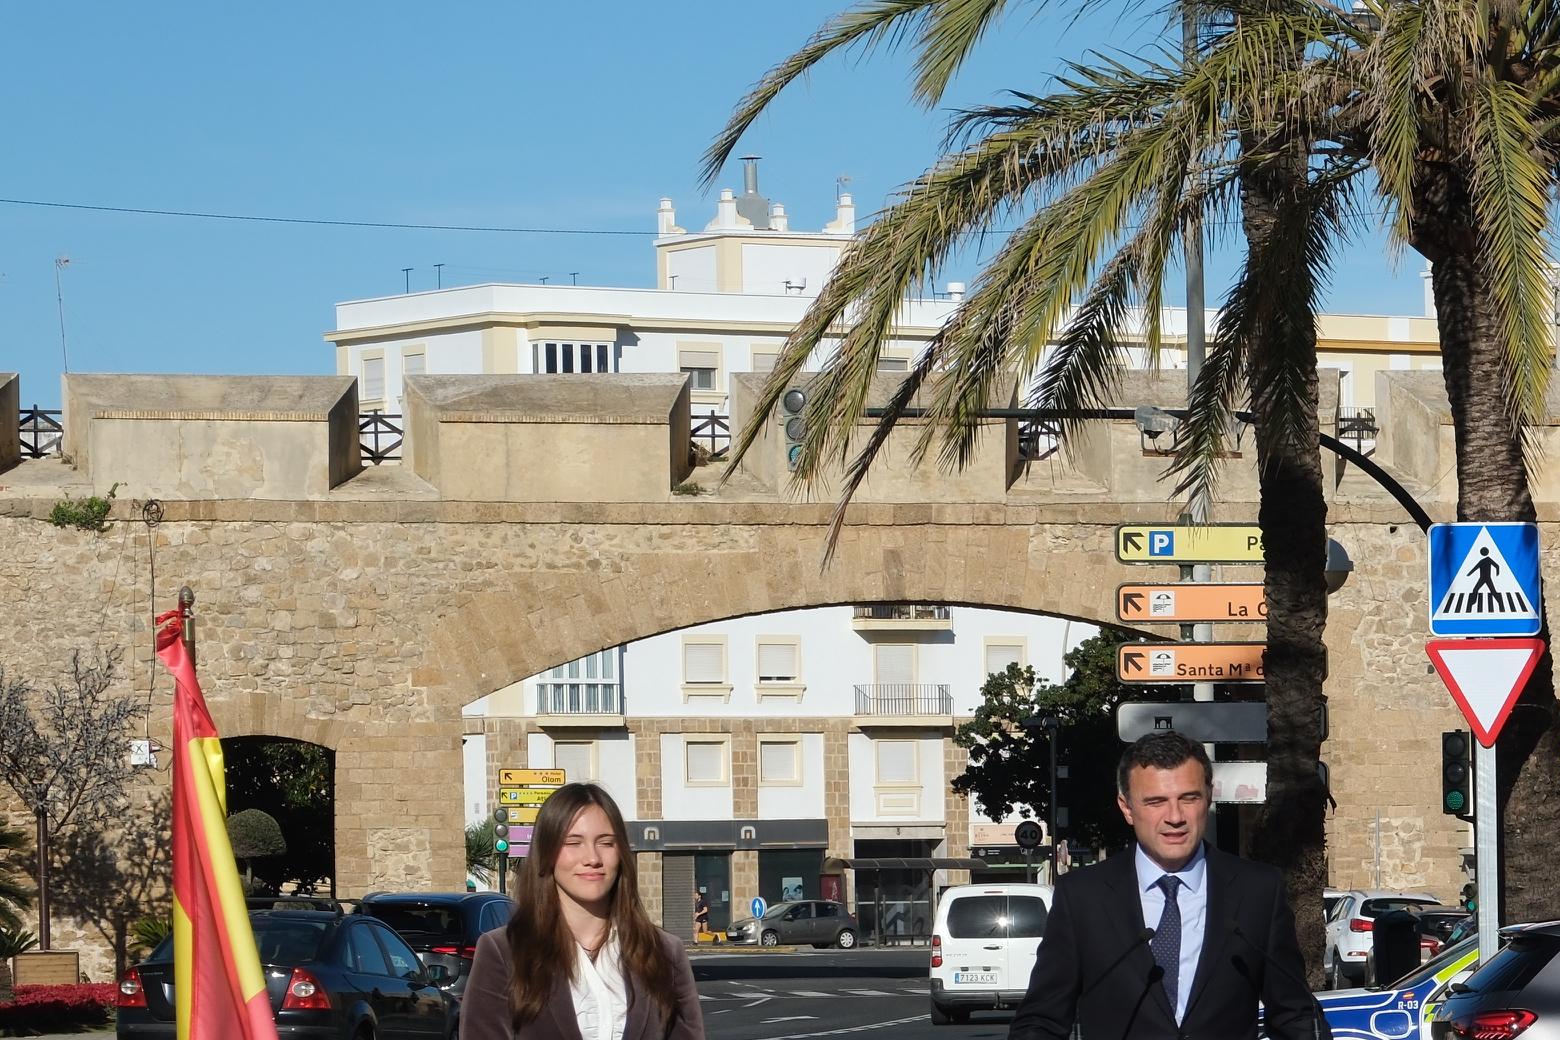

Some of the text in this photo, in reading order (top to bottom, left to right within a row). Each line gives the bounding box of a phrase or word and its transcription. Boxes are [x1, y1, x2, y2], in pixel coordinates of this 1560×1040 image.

[1228, 602, 1249, 616] La
[1176, 664, 1223, 676] Santa
[1397, 1000, 1419, 1010] R-03
